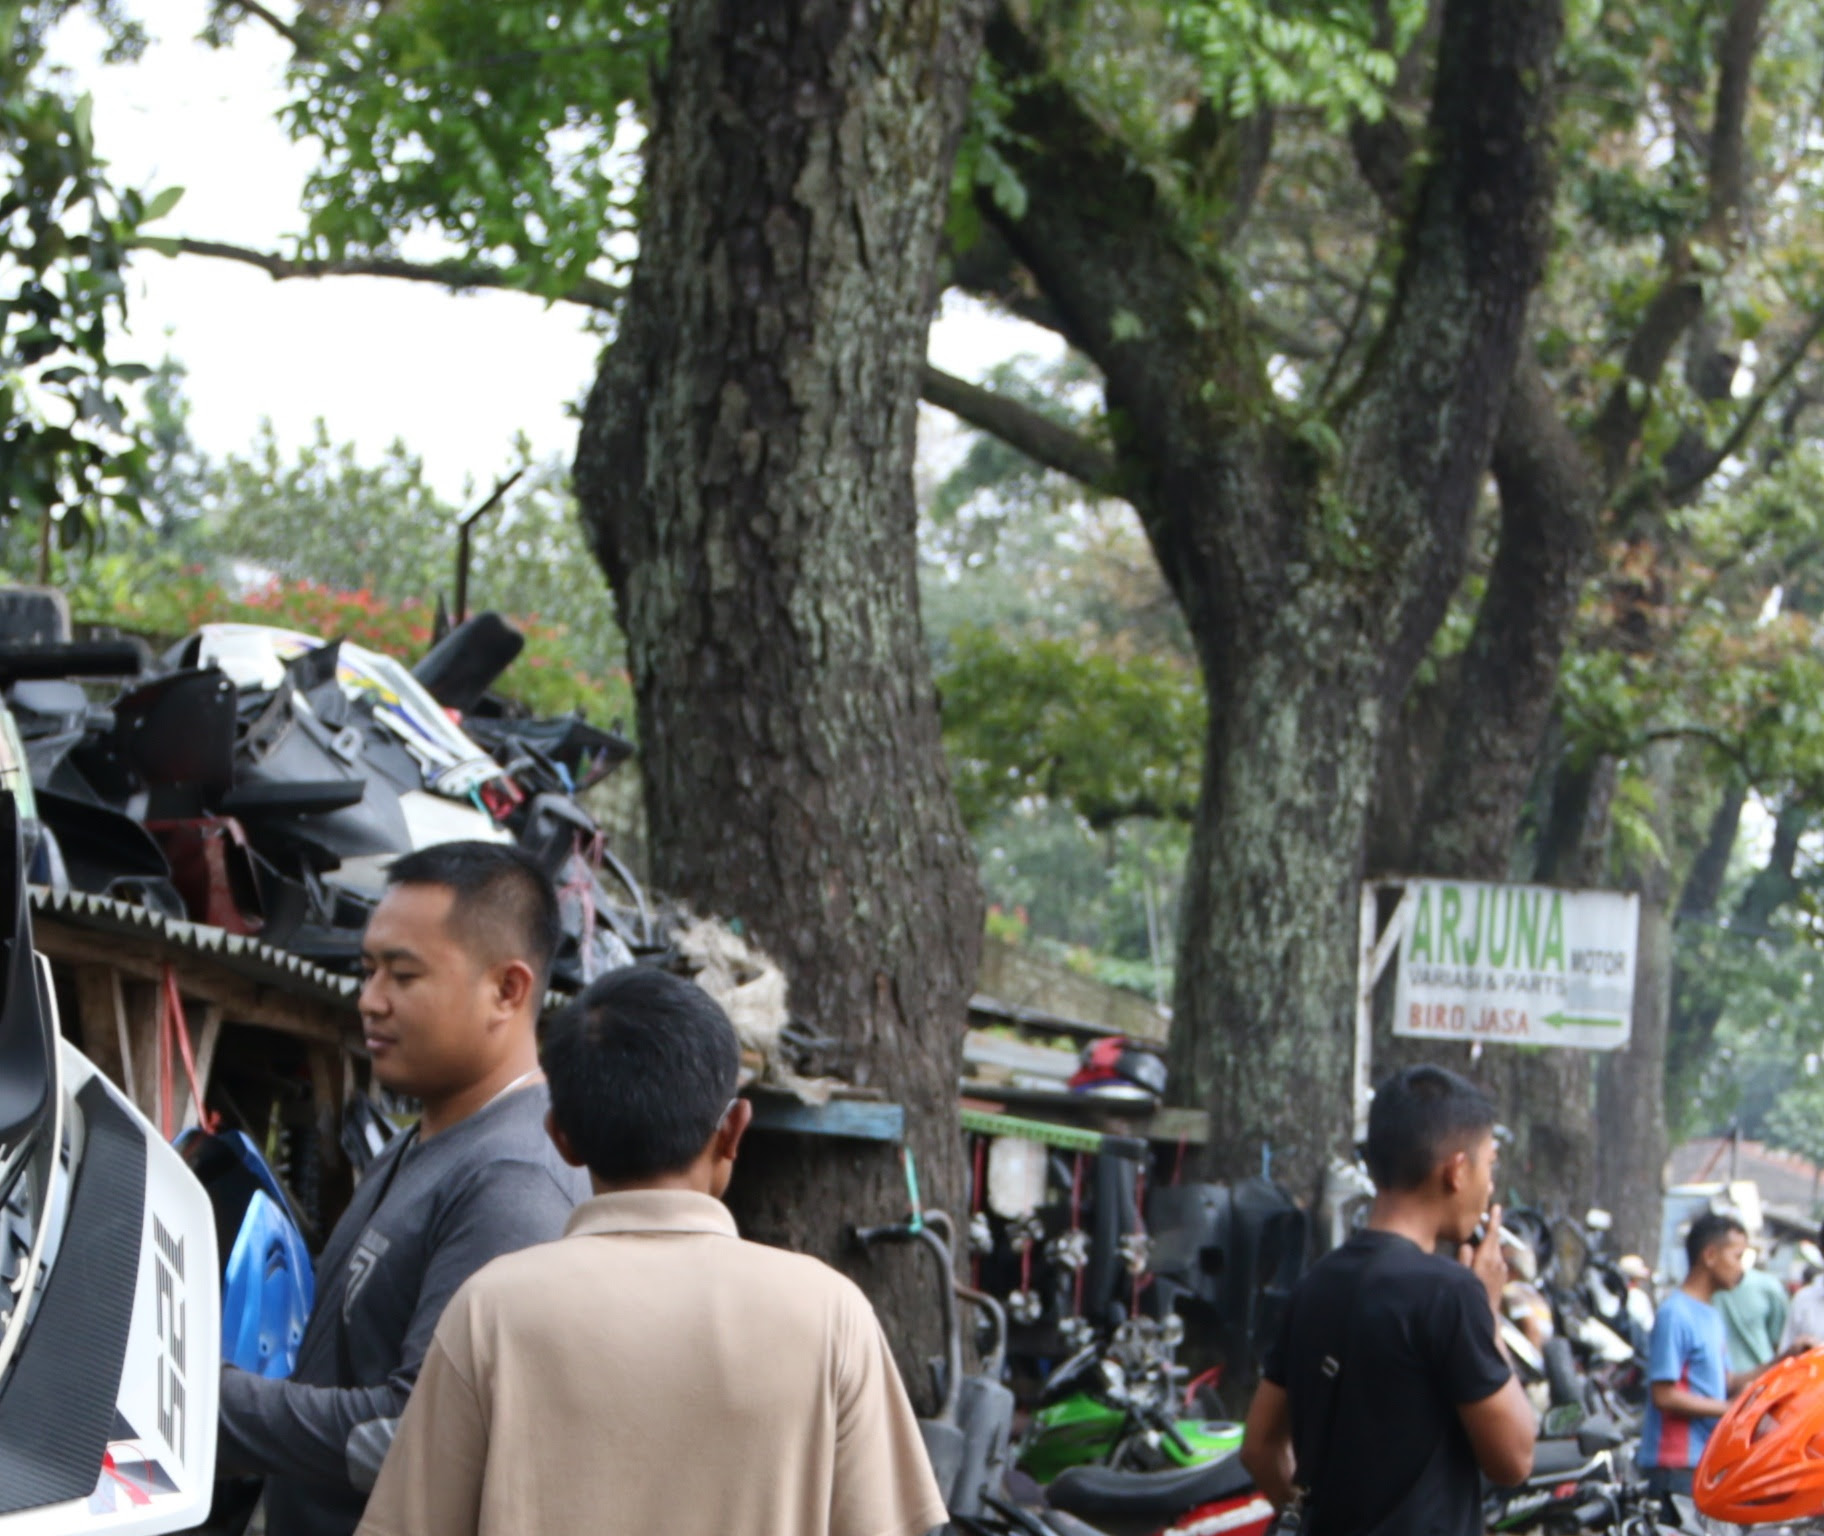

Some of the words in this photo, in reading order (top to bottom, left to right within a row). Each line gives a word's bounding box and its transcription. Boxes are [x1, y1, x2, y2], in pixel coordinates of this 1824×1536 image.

[1408, 884, 1565, 971] ARJUNA
[1571, 949, 1626, 976] MOTOR
[1408, 1003, 1465, 1031] BIRO
[1471, 1006, 1529, 1034] JASA
[153, 1211, 186, 1471] 125
